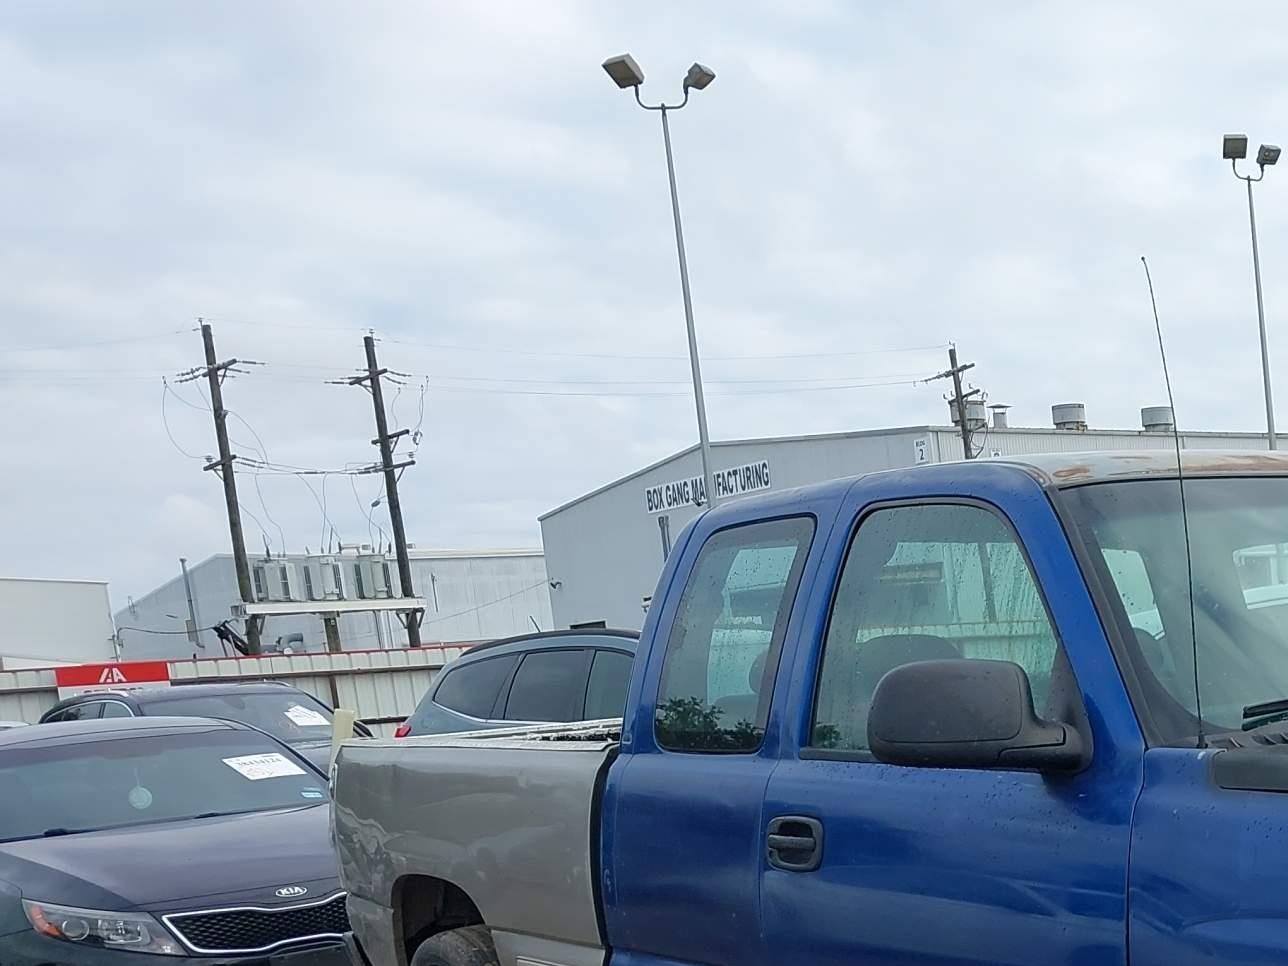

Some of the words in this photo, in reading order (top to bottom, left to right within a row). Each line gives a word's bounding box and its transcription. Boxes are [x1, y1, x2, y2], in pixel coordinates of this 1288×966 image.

[919, 448, 925, 460] 2
[646, 488, 665, 512] BOX
[665, 480, 690, 505] GANG
[691, 461, 770, 502] MAFACTURING
[278, 886, 305, 897] KIA
